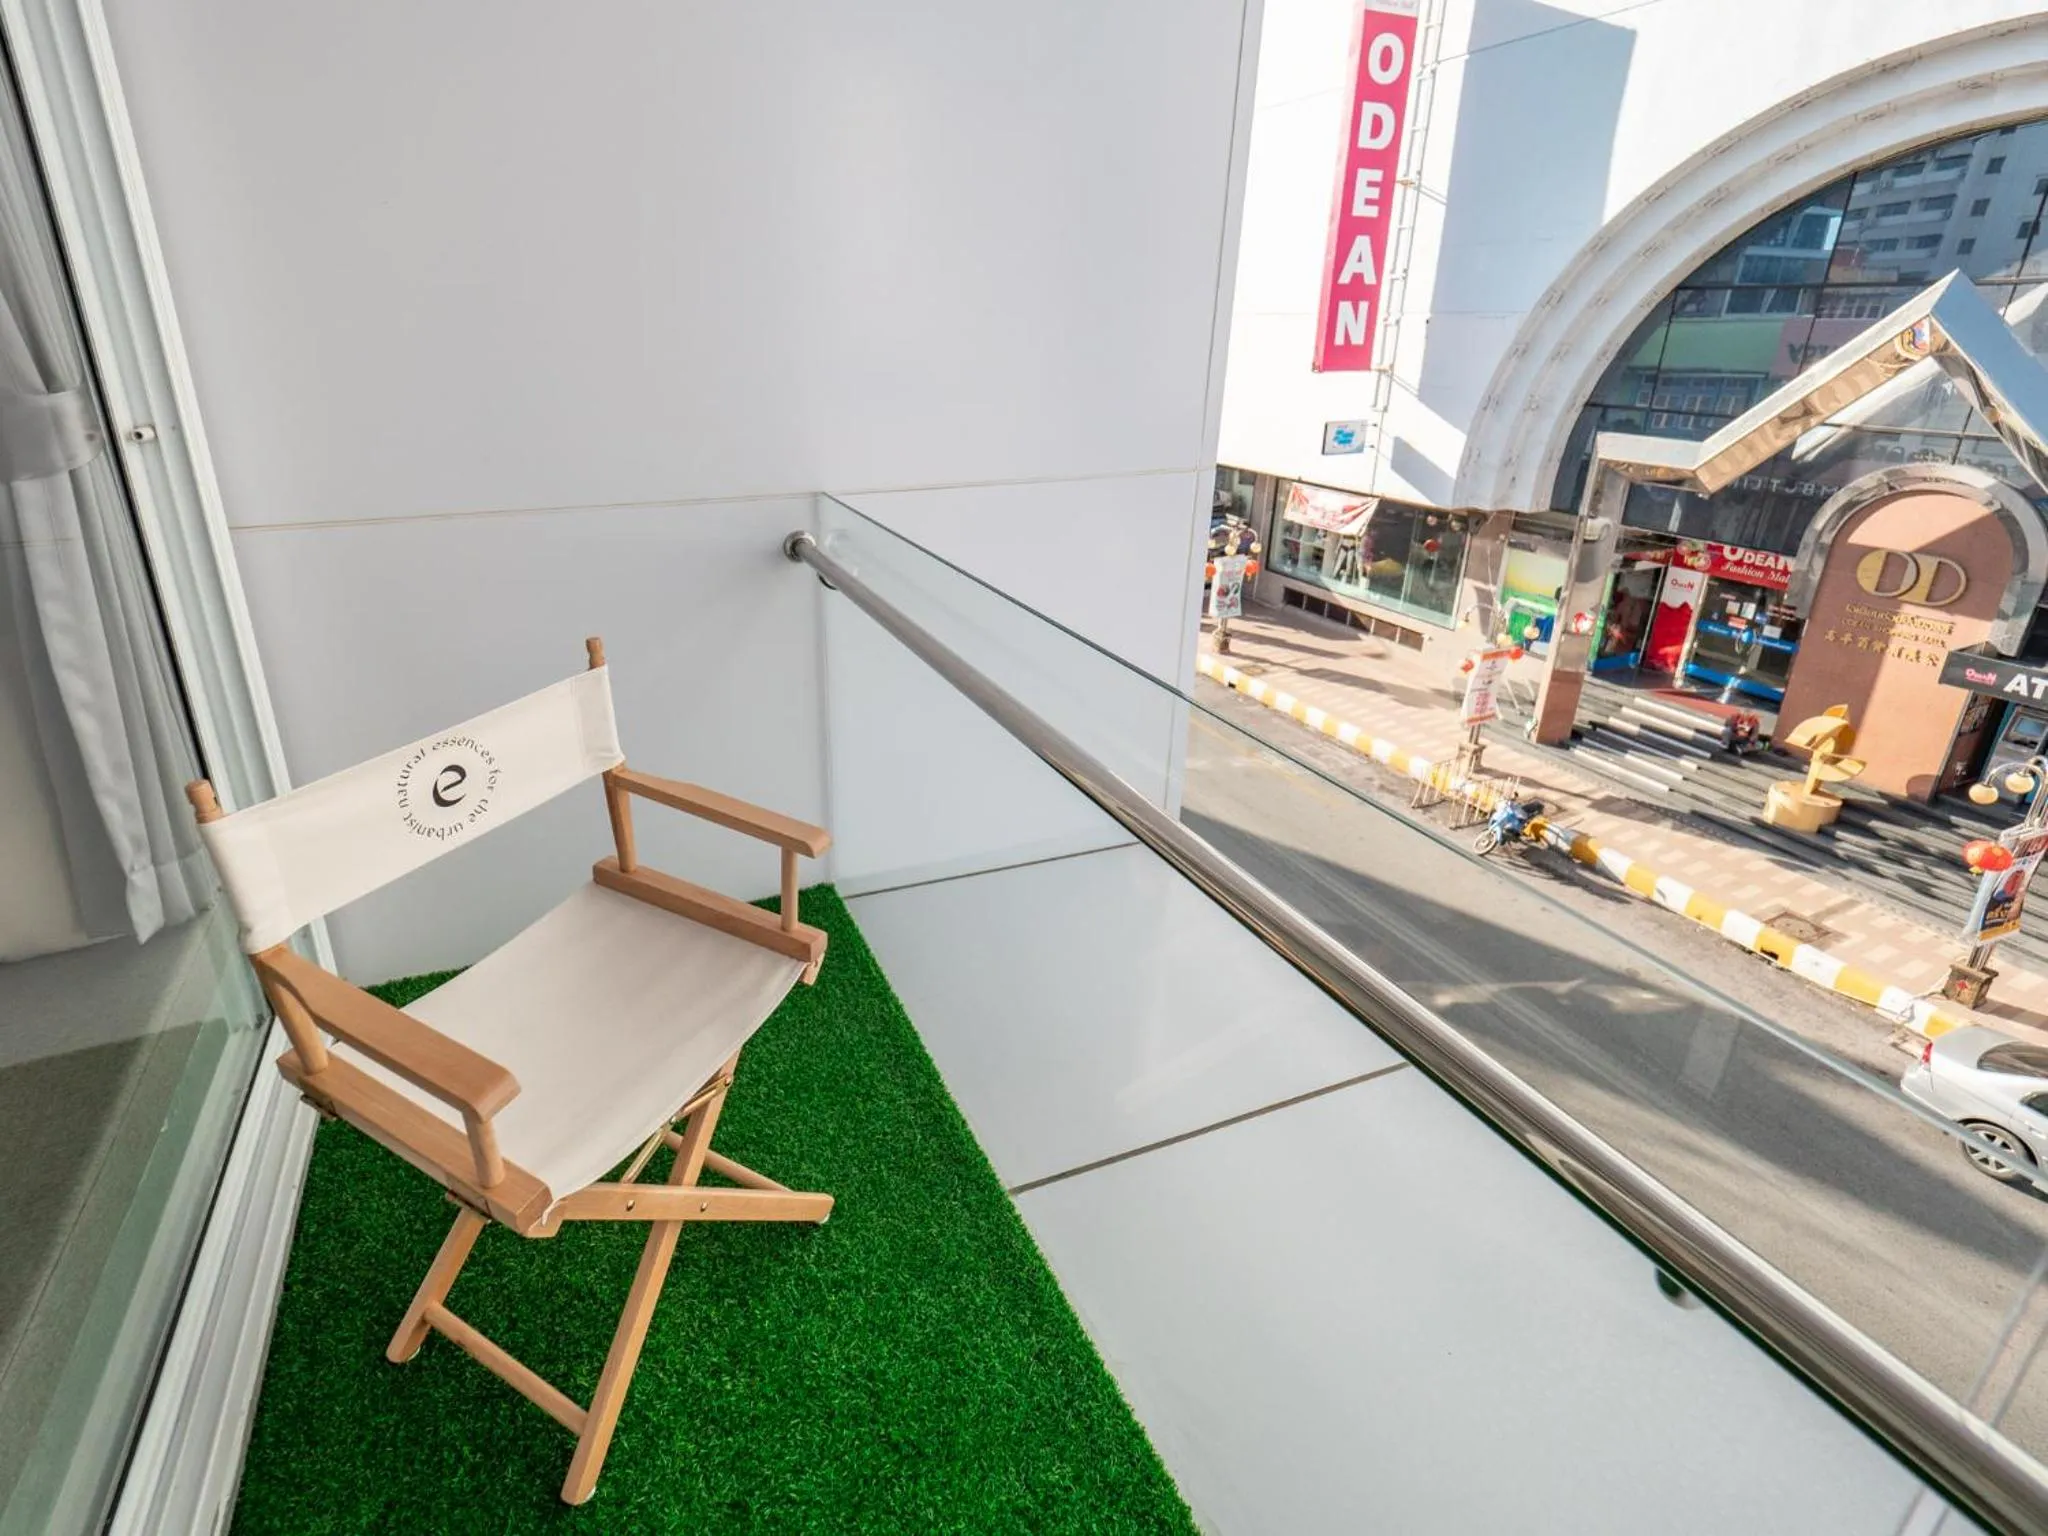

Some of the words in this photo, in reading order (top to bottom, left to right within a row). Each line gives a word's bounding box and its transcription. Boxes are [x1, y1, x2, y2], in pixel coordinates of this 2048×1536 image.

[1333, 32, 1405, 346] ODEAN
[1720, 562, 1764, 579] Fashion
[432, 736, 496, 765] essences
[397, 747, 427, 809] natural
[486, 768, 502, 793] for
[468, 798, 489, 823] the
[403, 812, 464, 841] urbanist
